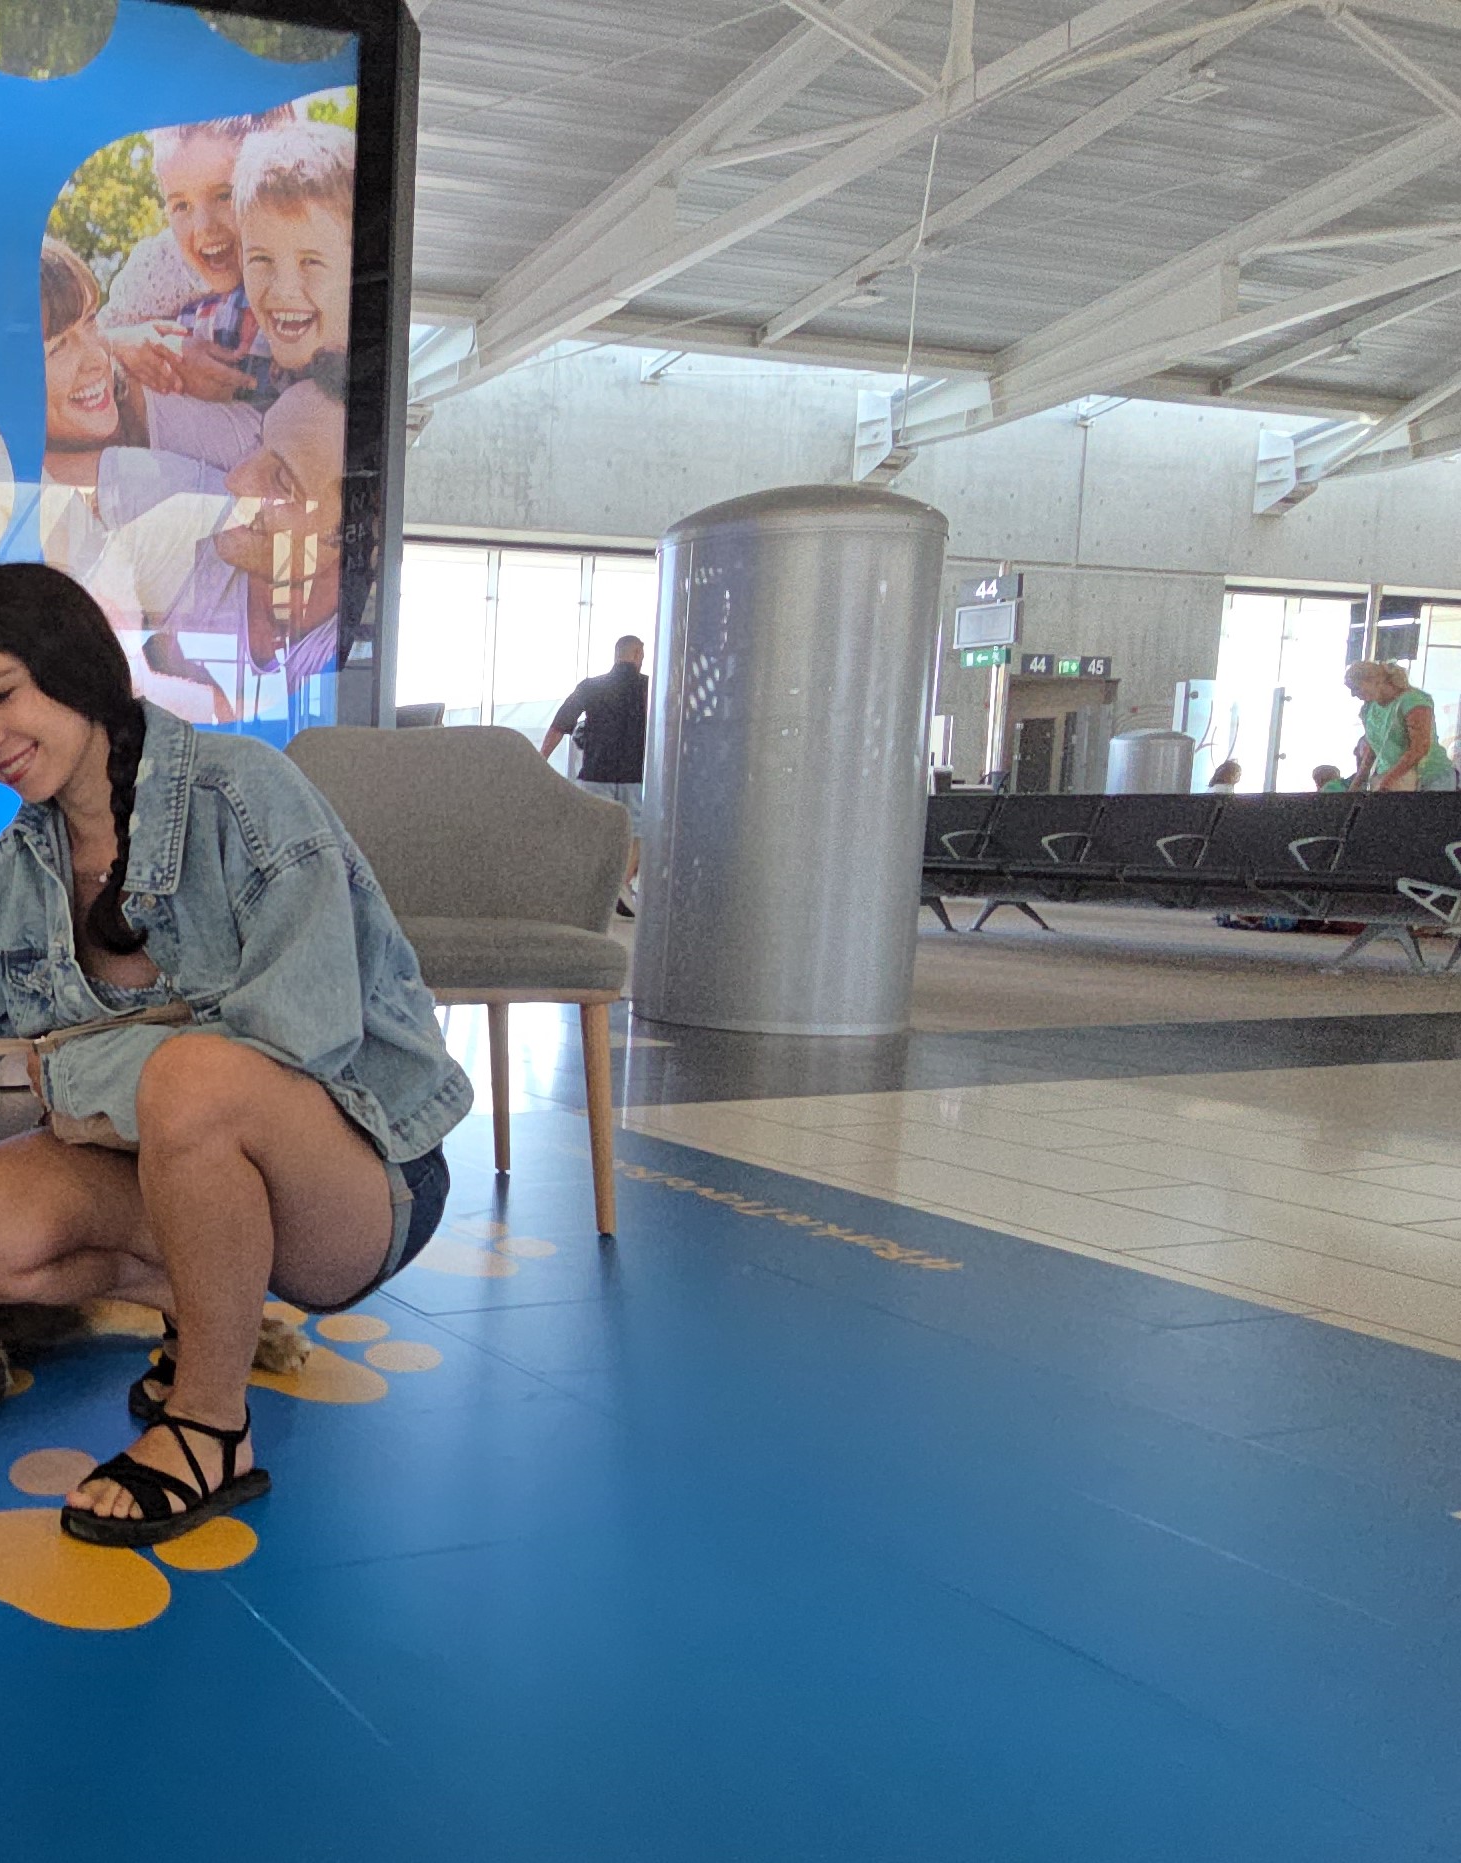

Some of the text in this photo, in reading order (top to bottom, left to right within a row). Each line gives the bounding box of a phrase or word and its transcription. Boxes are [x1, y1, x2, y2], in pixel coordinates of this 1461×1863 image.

[975, 579, 999, 600] 44
[1029, 656, 1046, 673] 44
[1087, 658, 1104, 675] 45
